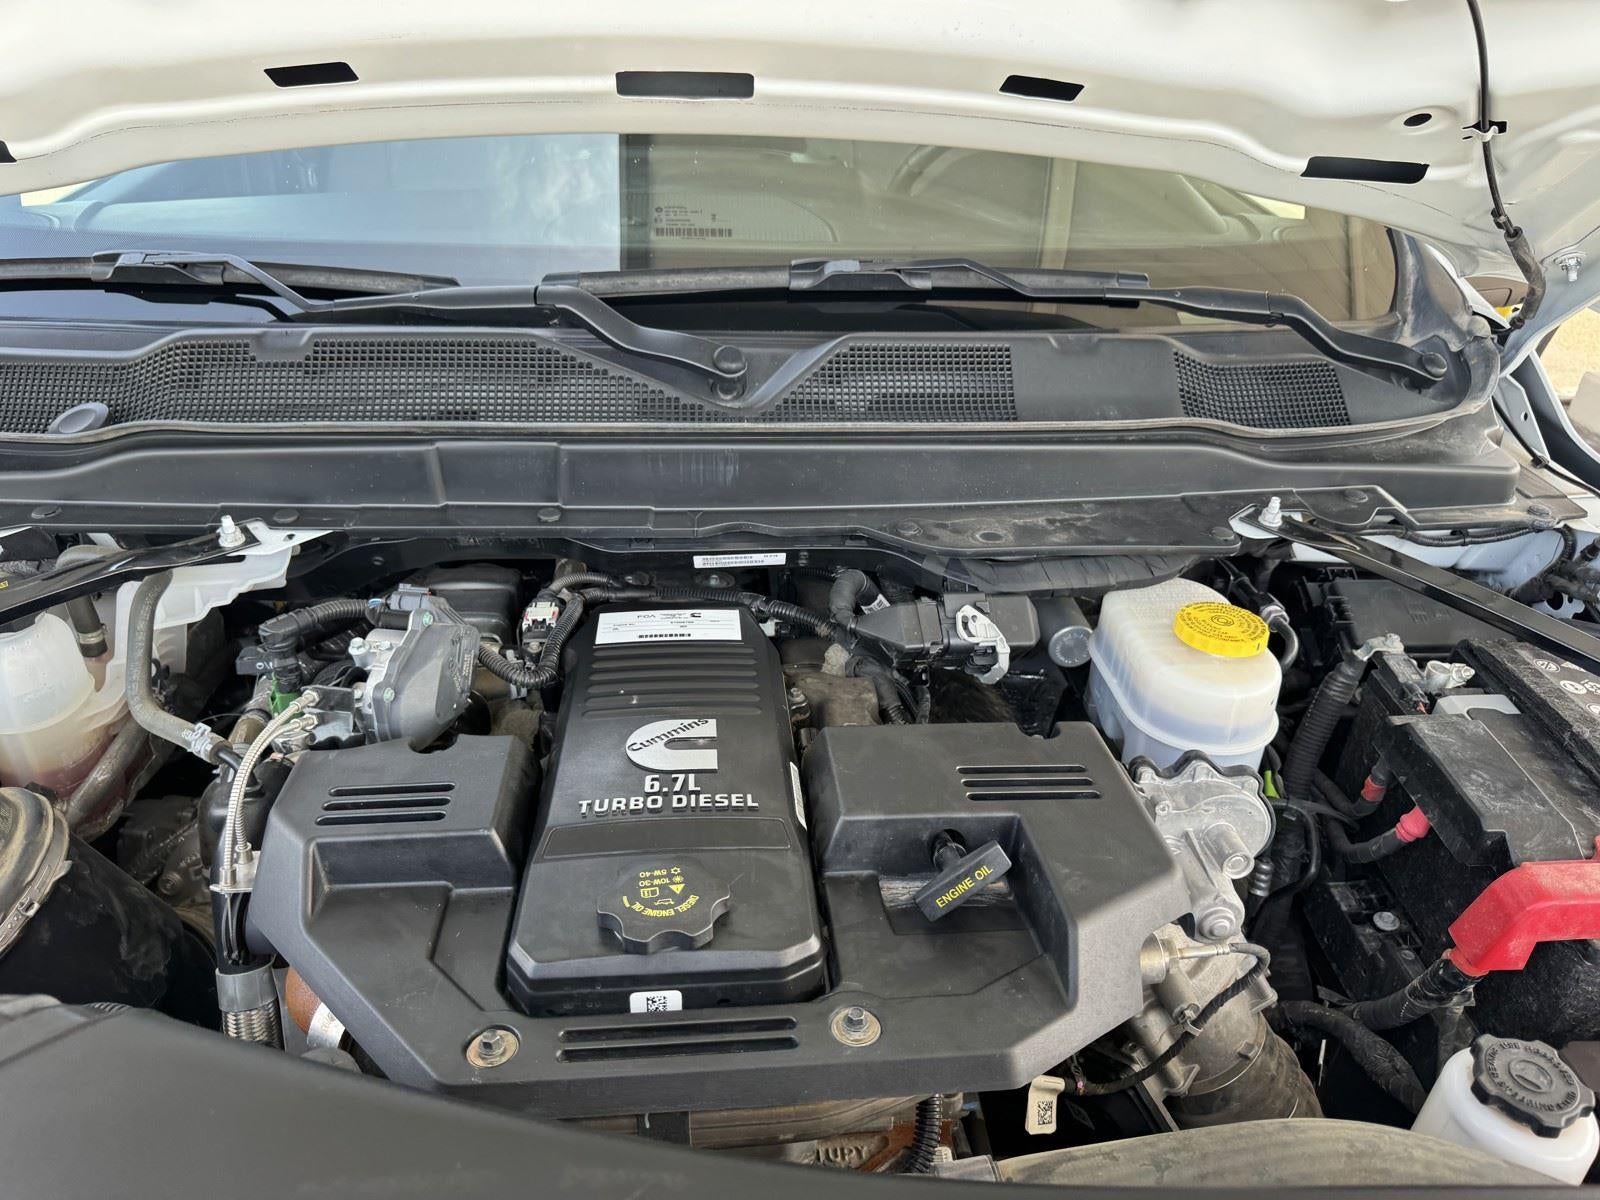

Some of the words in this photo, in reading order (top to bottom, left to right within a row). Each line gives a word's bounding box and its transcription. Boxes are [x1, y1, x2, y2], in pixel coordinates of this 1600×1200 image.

[627, 719, 709, 751] Cummins
[644, 773, 701, 793] 6.7L
[578, 795, 663, 816] TURBO
[672, 793, 759, 810] DIESEL
[639, 868, 667, 878] 5W-40
[639, 877, 671, 887] 10W-30
[935, 877, 976, 908] ENGINE
[974, 865, 994, 881] OIL
[631, 901, 645, 912] OIL
[641, 908, 675, 917] ENGINE
[674, 894, 700, 913] DIESEL
